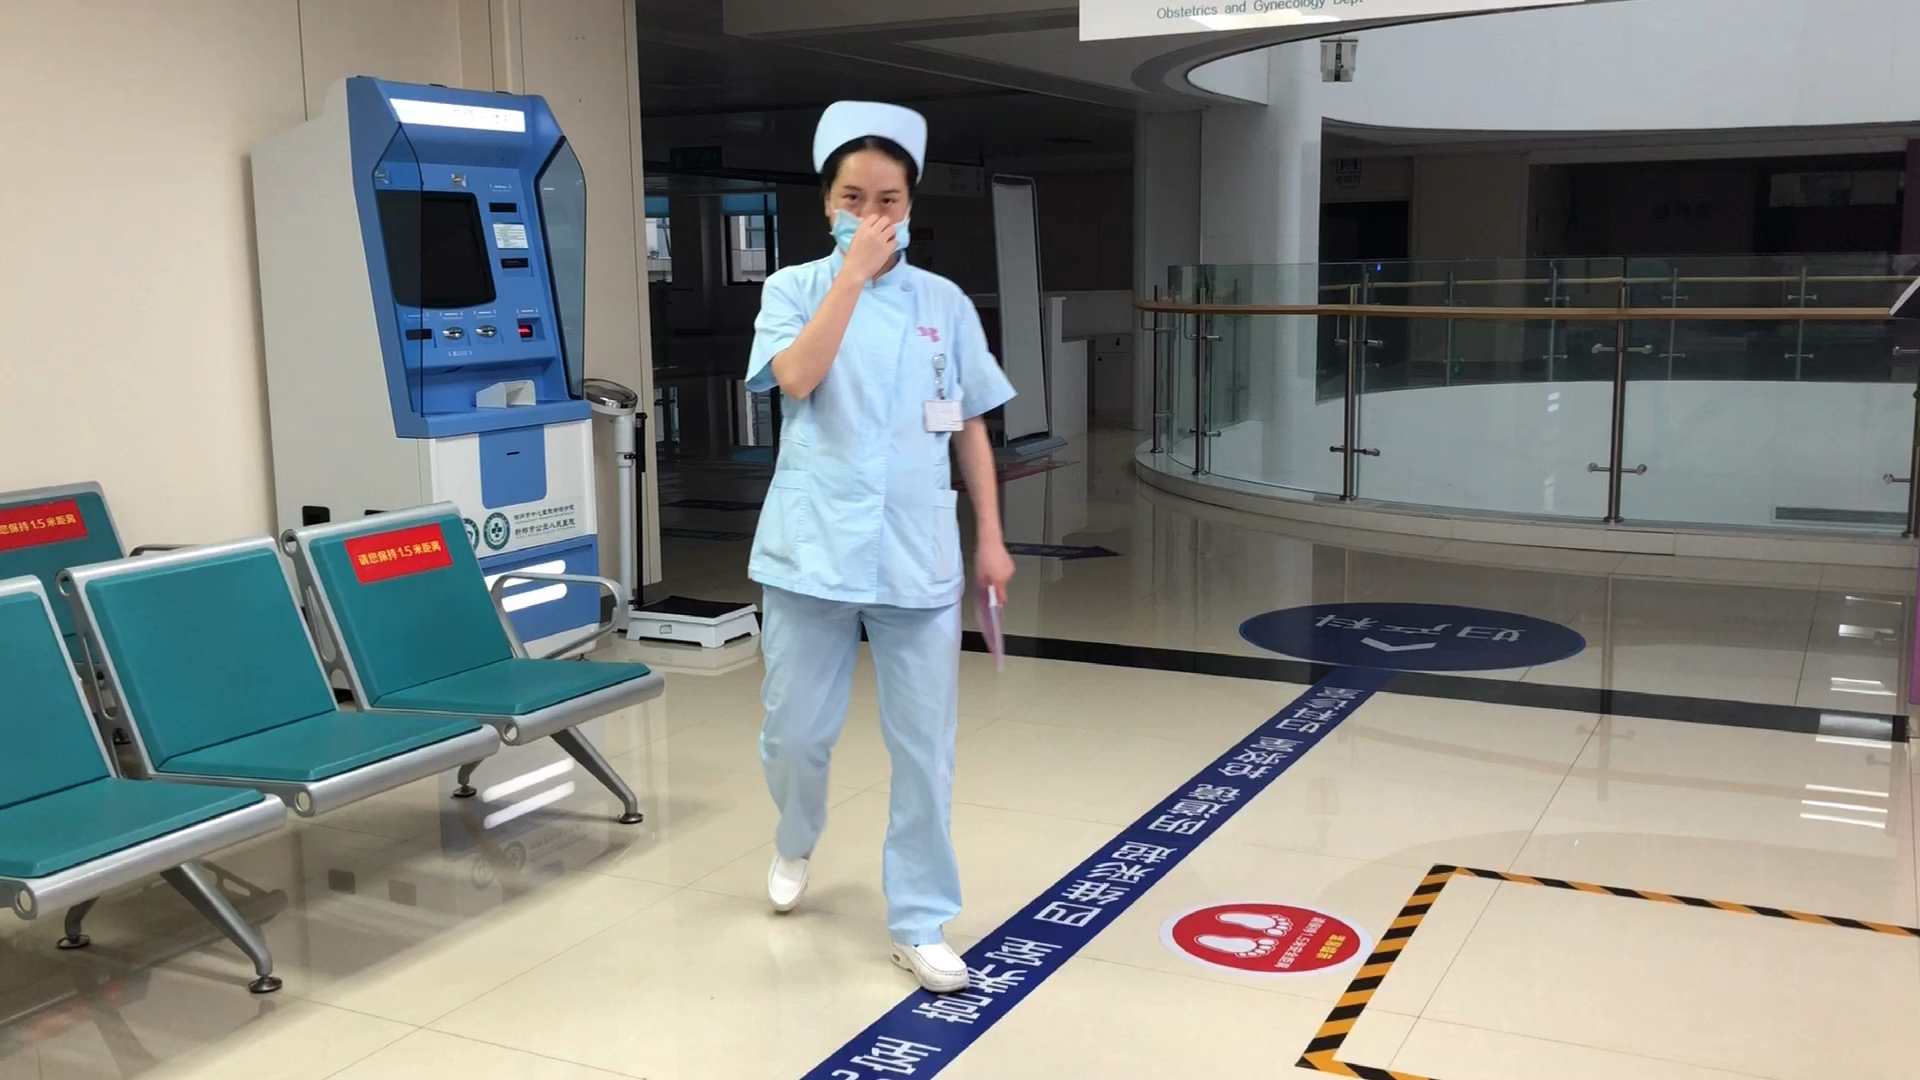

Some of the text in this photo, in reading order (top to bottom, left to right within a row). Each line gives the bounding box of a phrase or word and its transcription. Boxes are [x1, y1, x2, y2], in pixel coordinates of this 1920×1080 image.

[1157, 5, 1218, 19] Obstetrics
[1225, 1, 1247, 14] and
[1254, 0, 1325, 12] Gynecology
[357, 540, 442, 566] 请您保持1.5米距离
[1315, 614, 1526, 642] 妇产科
[831, 687, 1364, 1080] 室 营养室 四维彩超 阴道镜 抢救室 妇科诊室
